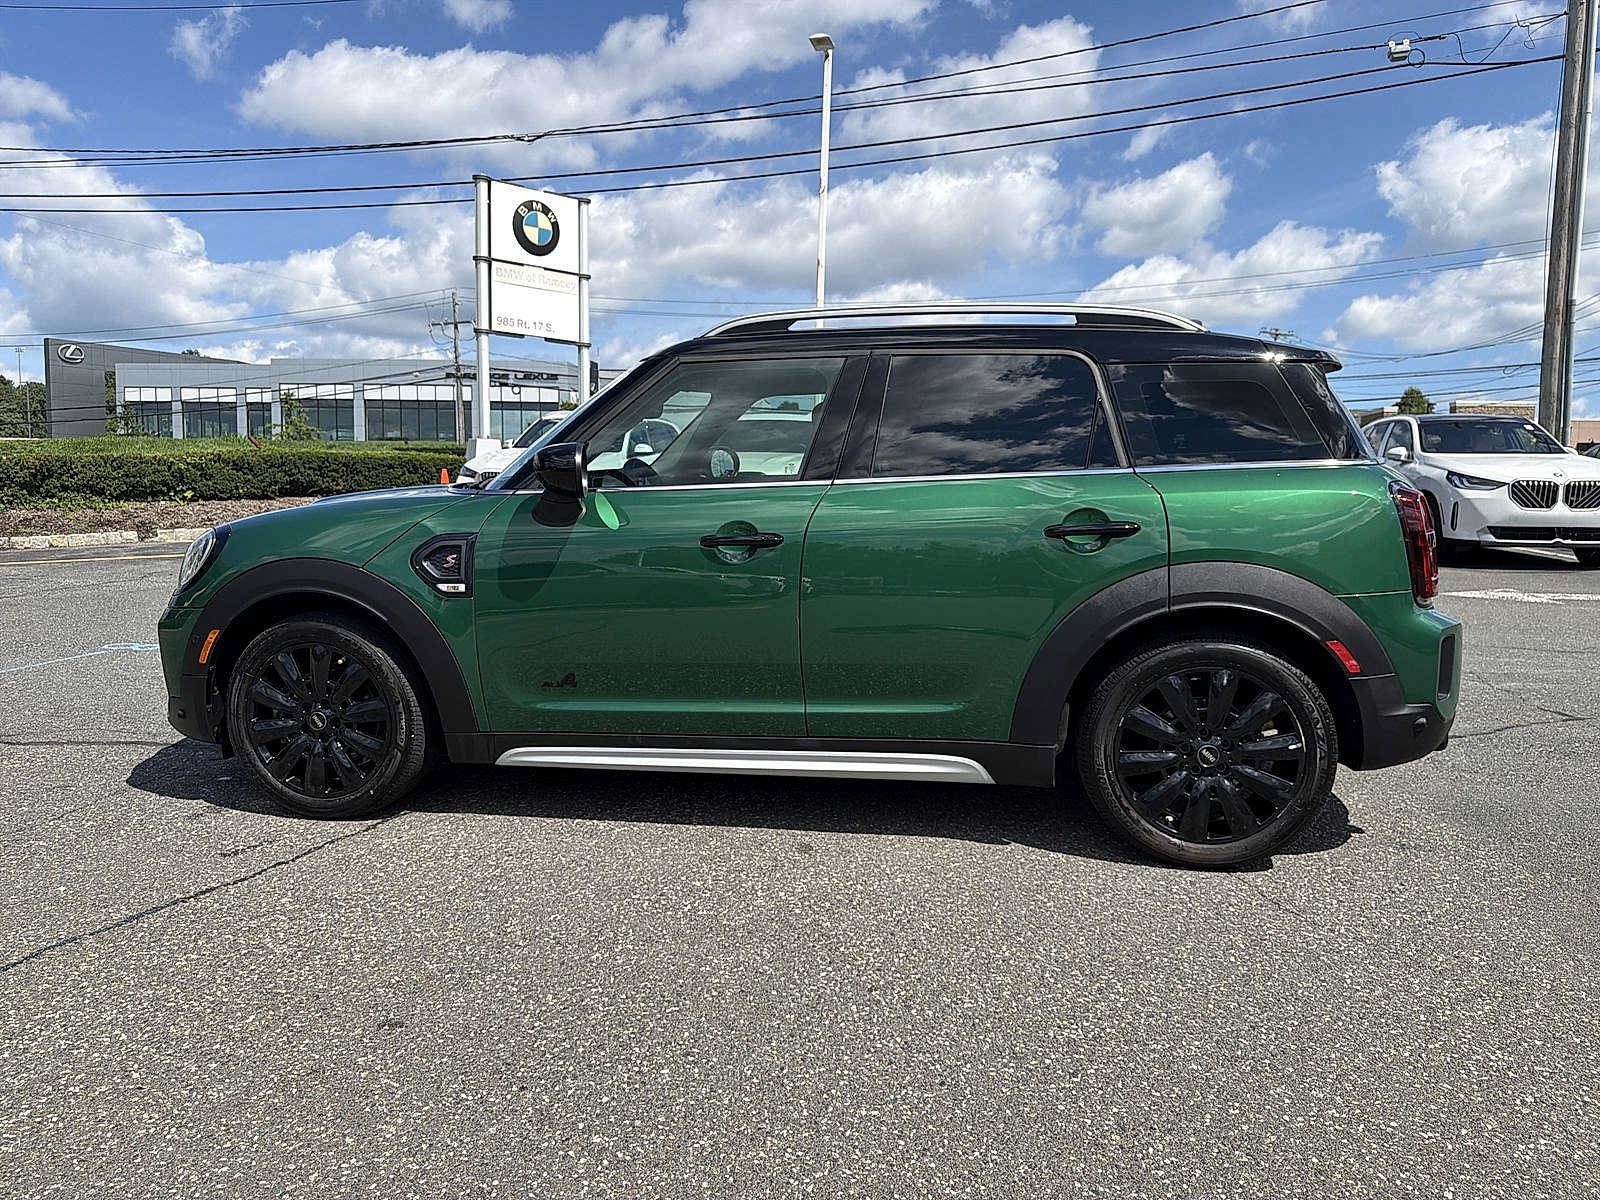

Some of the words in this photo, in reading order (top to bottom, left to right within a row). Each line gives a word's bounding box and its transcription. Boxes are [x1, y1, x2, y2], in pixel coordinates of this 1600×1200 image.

[517, 200, 557, 223] BMW
[495, 267, 524, 281] BMW
[496, 316, 515, 328] 985
[516, 318, 531, 329] Rt.
[533, 321, 544, 331] 17
[545, 323, 556, 333] S.
[513, 373, 559, 381] LEXUS
